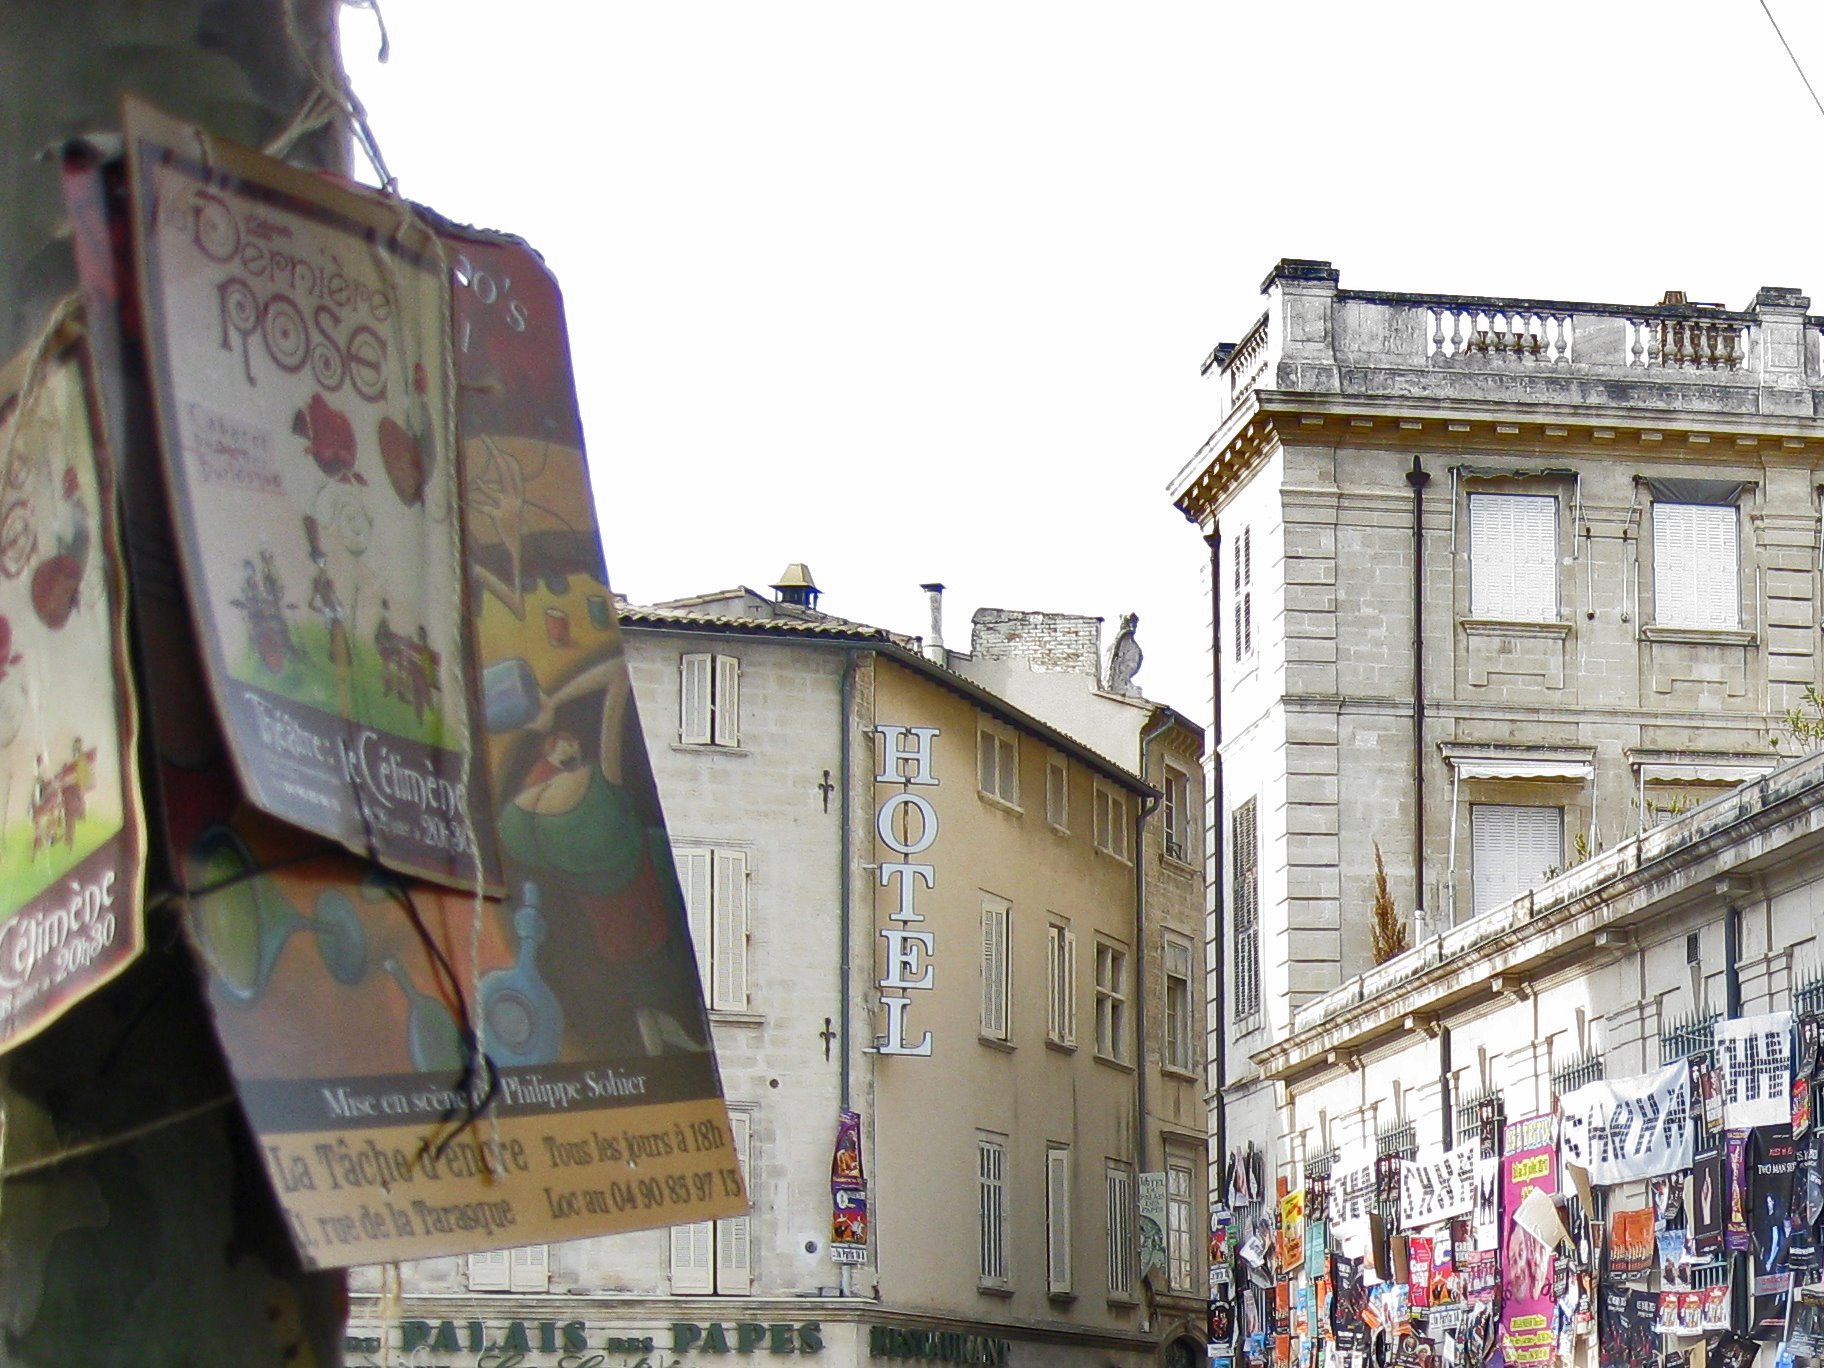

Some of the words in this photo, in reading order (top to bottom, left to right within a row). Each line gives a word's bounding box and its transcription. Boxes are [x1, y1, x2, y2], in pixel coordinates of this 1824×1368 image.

[194, 190, 391, 321] Dernière
[874, 724, 941, 1057] HOTEL
[322, 1086, 377, 1118] Mise
[381, 1093, 409, 1114] en
[416, 1085, 467, 1112] scène
[502, 1076, 581, 1107] Philippe
[584, 1068, 647, 1097] Sohier
[266, 1145, 316, 1192] La
[315, 1136, 414, 1190] Tâche
[542, 1135, 594, 1168] Tous
[593, 1131, 621, 1162] les
[623, 1127, 672, 1167] jours
[674, 1122, 690, 1154] à
[689, 1119, 725, 1153] 18h
[543, 1188, 581, 1220] Loc
[584, 1188, 611, 1215] au
[610, 1180, 638, 1212] 04
[638, 1176, 664, 1210] 90
[665, 1174, 691, 1205] 85
[693, 1171, 713, 1202] 97
[318, 1214, 360, 1246] rue
[359, 1205, 390, 1240] de
[386, 1202, 415, 1236] la
[413, 1200, 516, 1236] Tarasque
[401, 1320, 588, 1352] PALAIS
[608, 1337, 655, 1354] DES
[671, 1320, 824, 1355] PAPES
